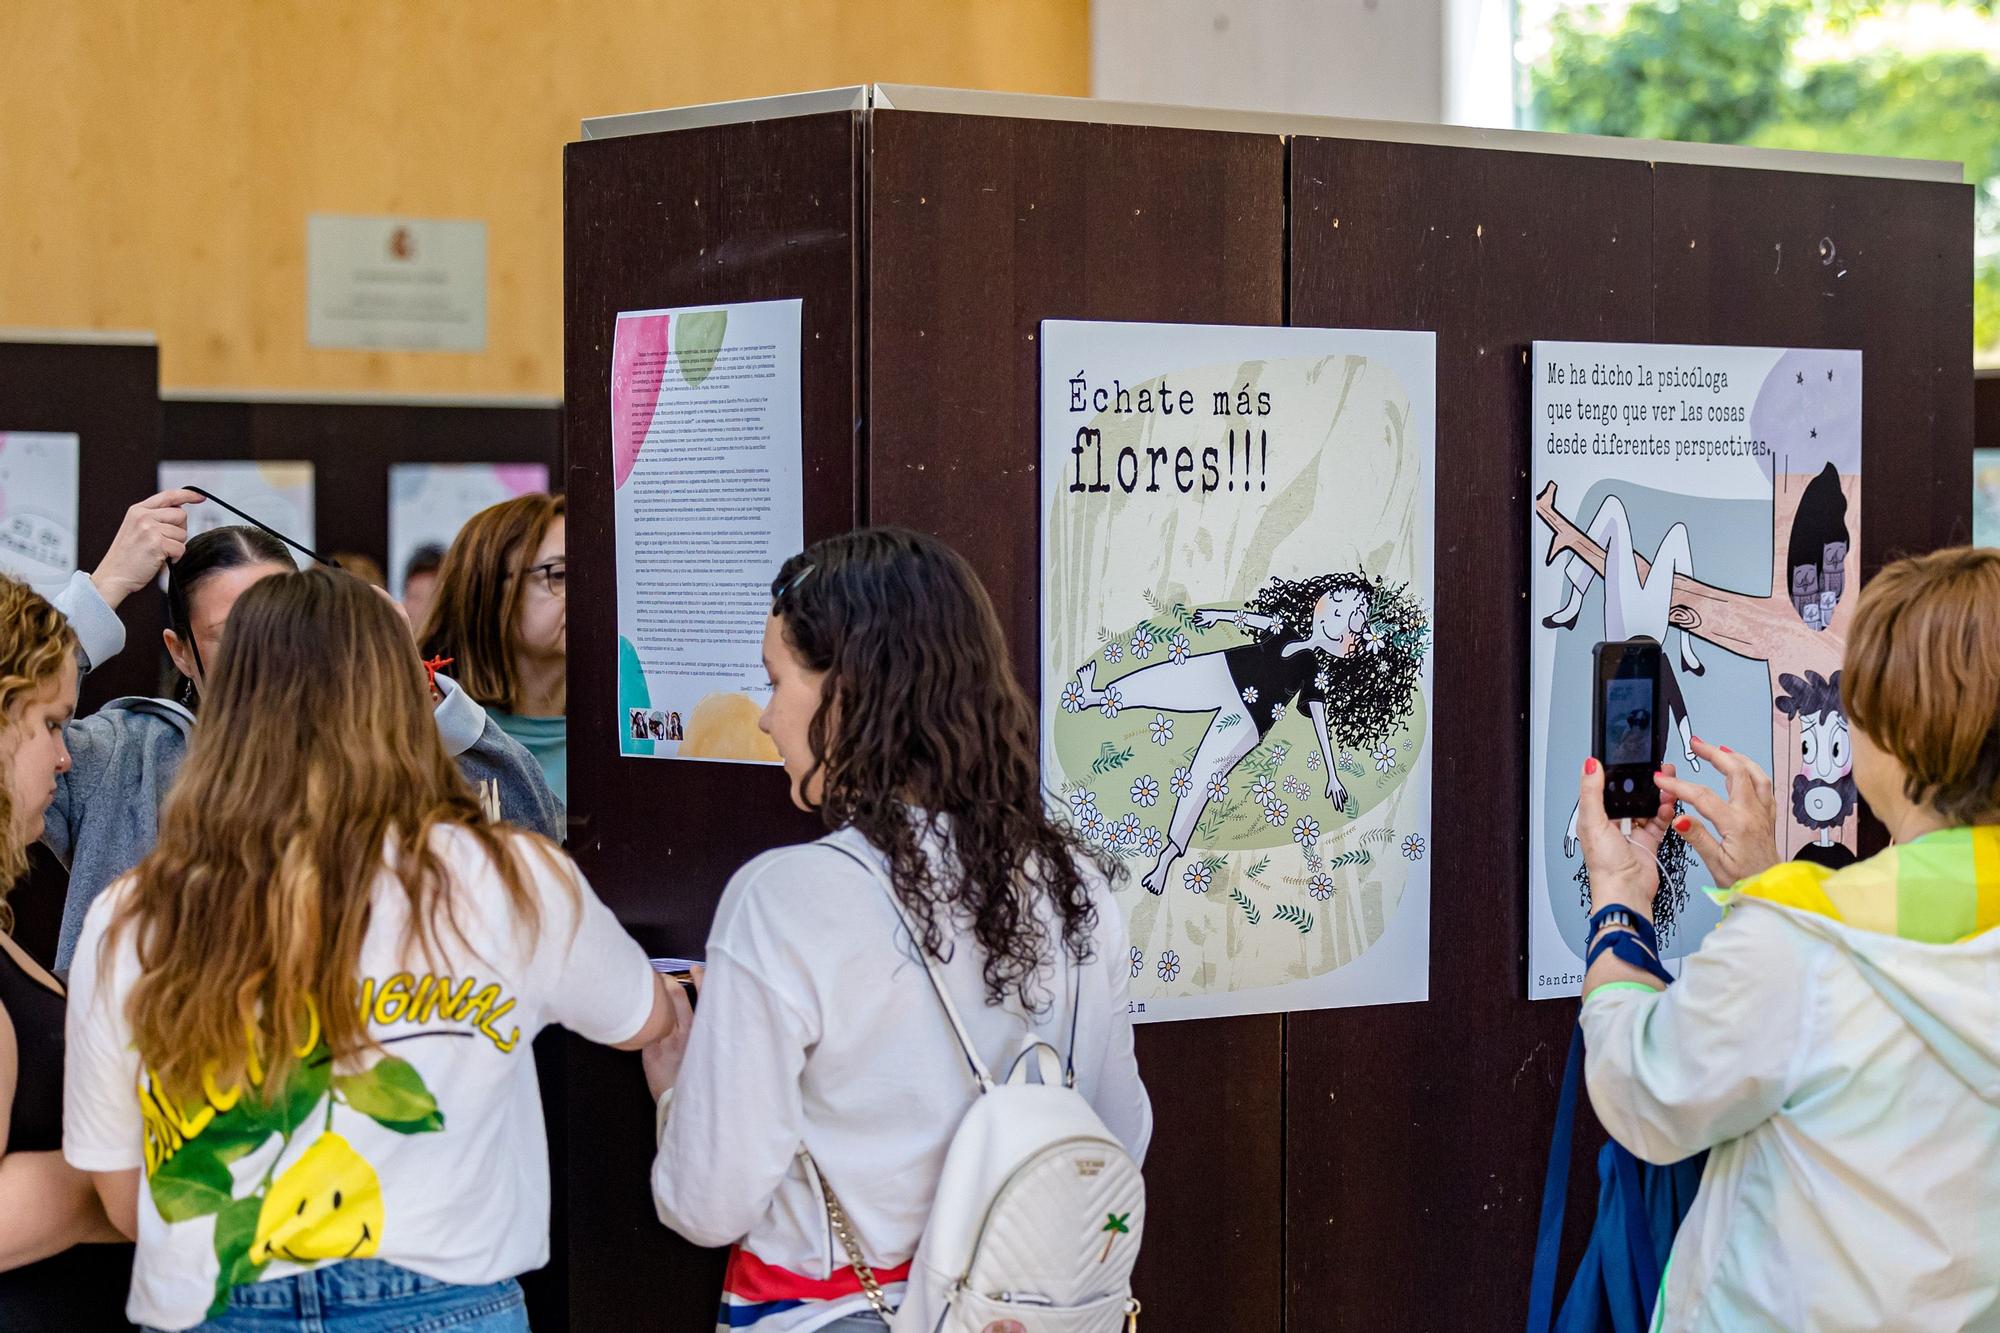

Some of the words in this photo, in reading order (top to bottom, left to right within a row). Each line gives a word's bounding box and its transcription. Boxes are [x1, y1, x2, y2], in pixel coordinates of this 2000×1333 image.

[1068, 369, 1194, 415] Échate
[1212, 382, 1271, 417] más
[1547, 362, 1565, 385] Me
[1569, 363, 1587, 385] ha
[1591, 364, 1633, 387] dicho
[1637, 365, 1654, 387] la
[1657, 366, 1729, 394] psicóloga
[1547, 403, 1572, 425] que
[1577, 398, 1618, 427] tengo
[1622, 404, 1647, 427] que
[1651, 405, 1676, 422] ver
[1680, 400, 1703, 422] las
[1707, 406, 1745, 423] cosas
[1069, 426, 1267, 494] flores!!!
[1546, 432, 1587, 456] desde
[1592, 432, 1670, 456] diferentes
[1675, 435, 1771, 462] perspectivas.
